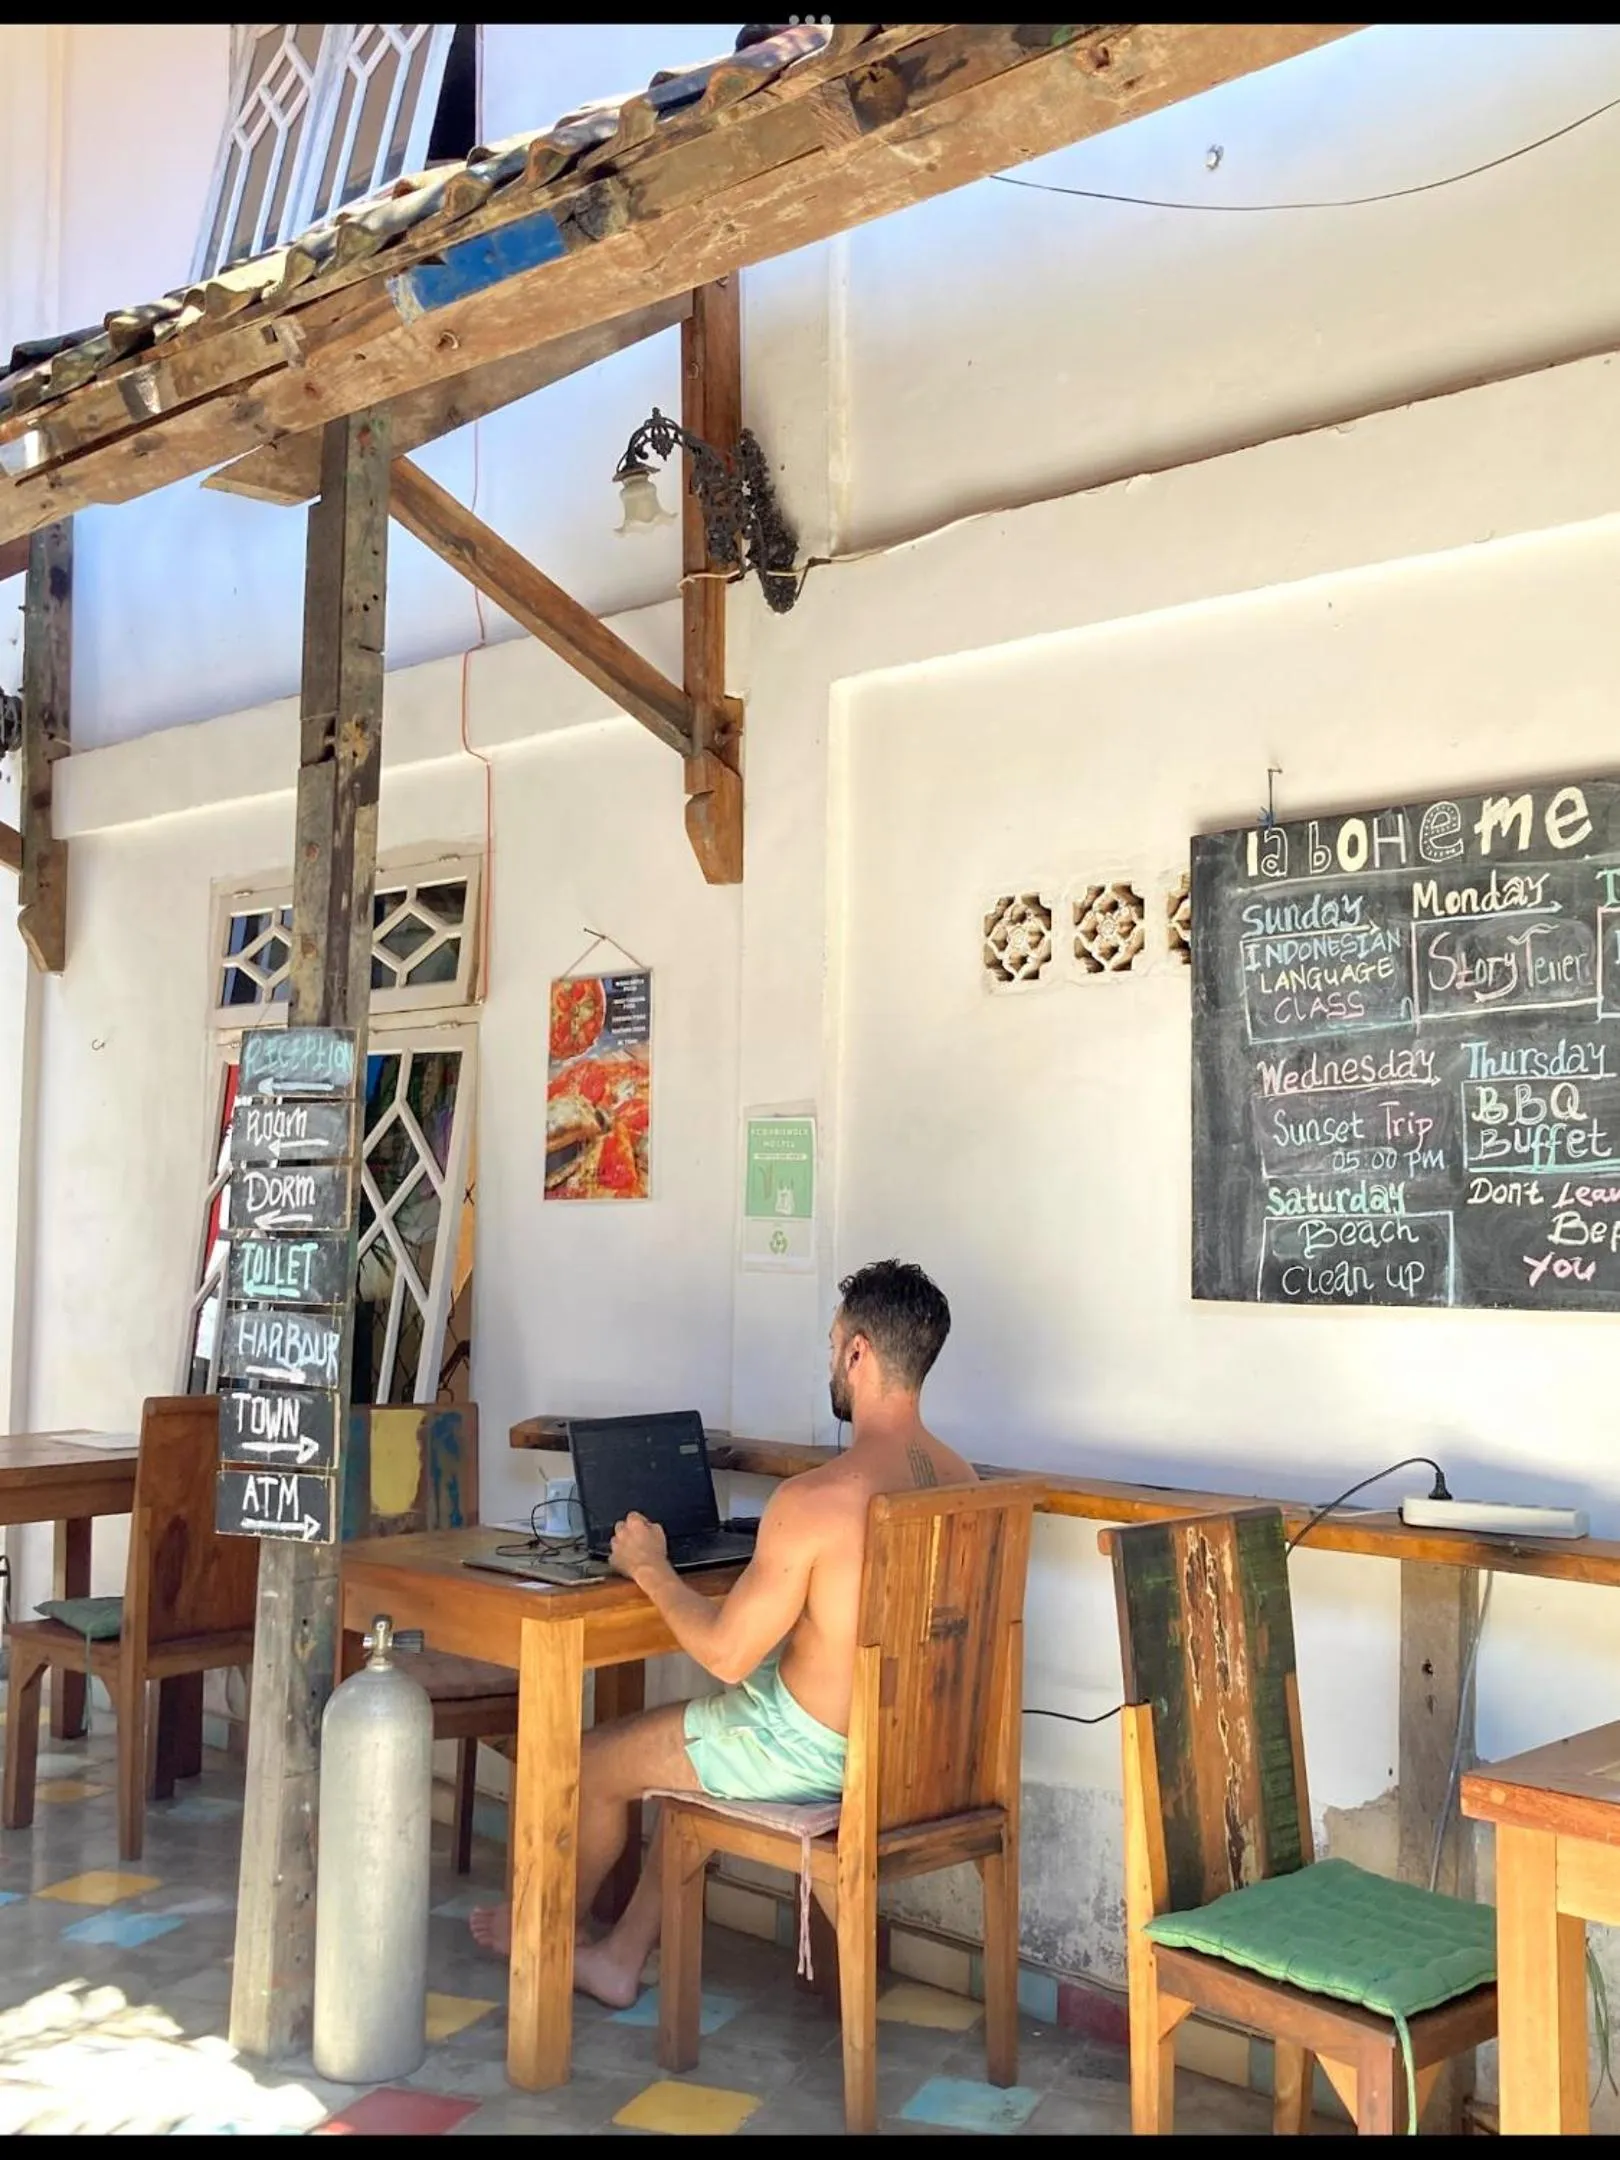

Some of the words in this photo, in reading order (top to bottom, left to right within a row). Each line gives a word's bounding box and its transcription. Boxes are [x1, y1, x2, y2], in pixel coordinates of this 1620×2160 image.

[1241, 893, 1364, 939] Sunday
[1413, 869, 1550, 919] Monday
[1244, 928, 1401, 972] INDONESIAN
[1260, 957, 1395, 994] LANGUAGE
[1257, 1049, 1436, 1093] Wednesday
[1461, 1039, 1606, 1080] Thursday
[1273, 1109, 1365, 1148] Sunset
[1379, 1100, 1434, 1151] Trip
[1471, 1083, 1588, 1127] BBQ
[1478, 1117, 1613, 1173] Buffet
[1298, 1218, 1420, 1260] Beach
[242, 1242, 318, 1291] TOILET
[232, 1393, 300, 1439] TOWN
[242, 1475, 299, 1521] ATM
